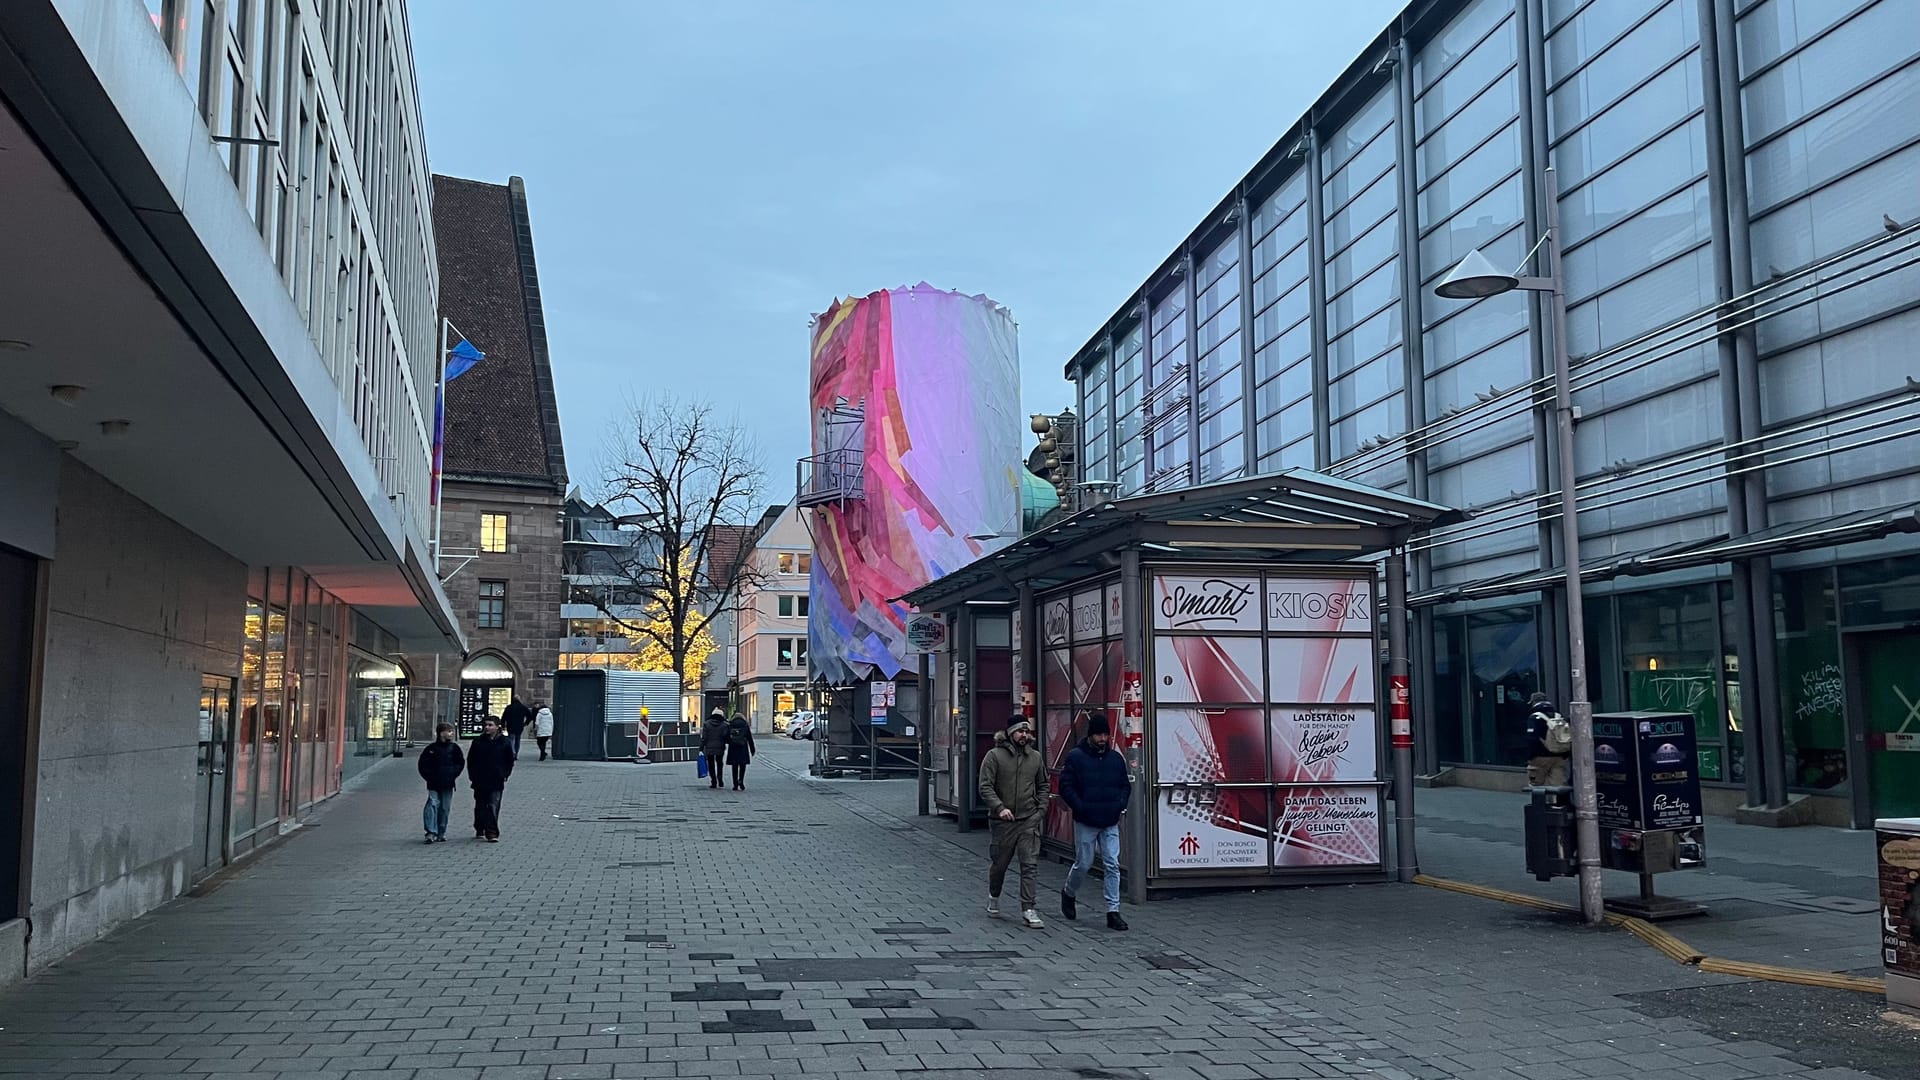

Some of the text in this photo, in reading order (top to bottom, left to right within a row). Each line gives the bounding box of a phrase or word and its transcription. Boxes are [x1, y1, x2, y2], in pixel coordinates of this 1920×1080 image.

[1161, 579, 1369, 620] Smart KIOSK
[1293, 713, 1356, 722] LADESTATION
[1285, 797, 1367, 806] DAMIT DAS LEBEN
[1276, 807, 1376, 829] junger Menschen
[1306, 824, 1349, 832] GELINGT.
